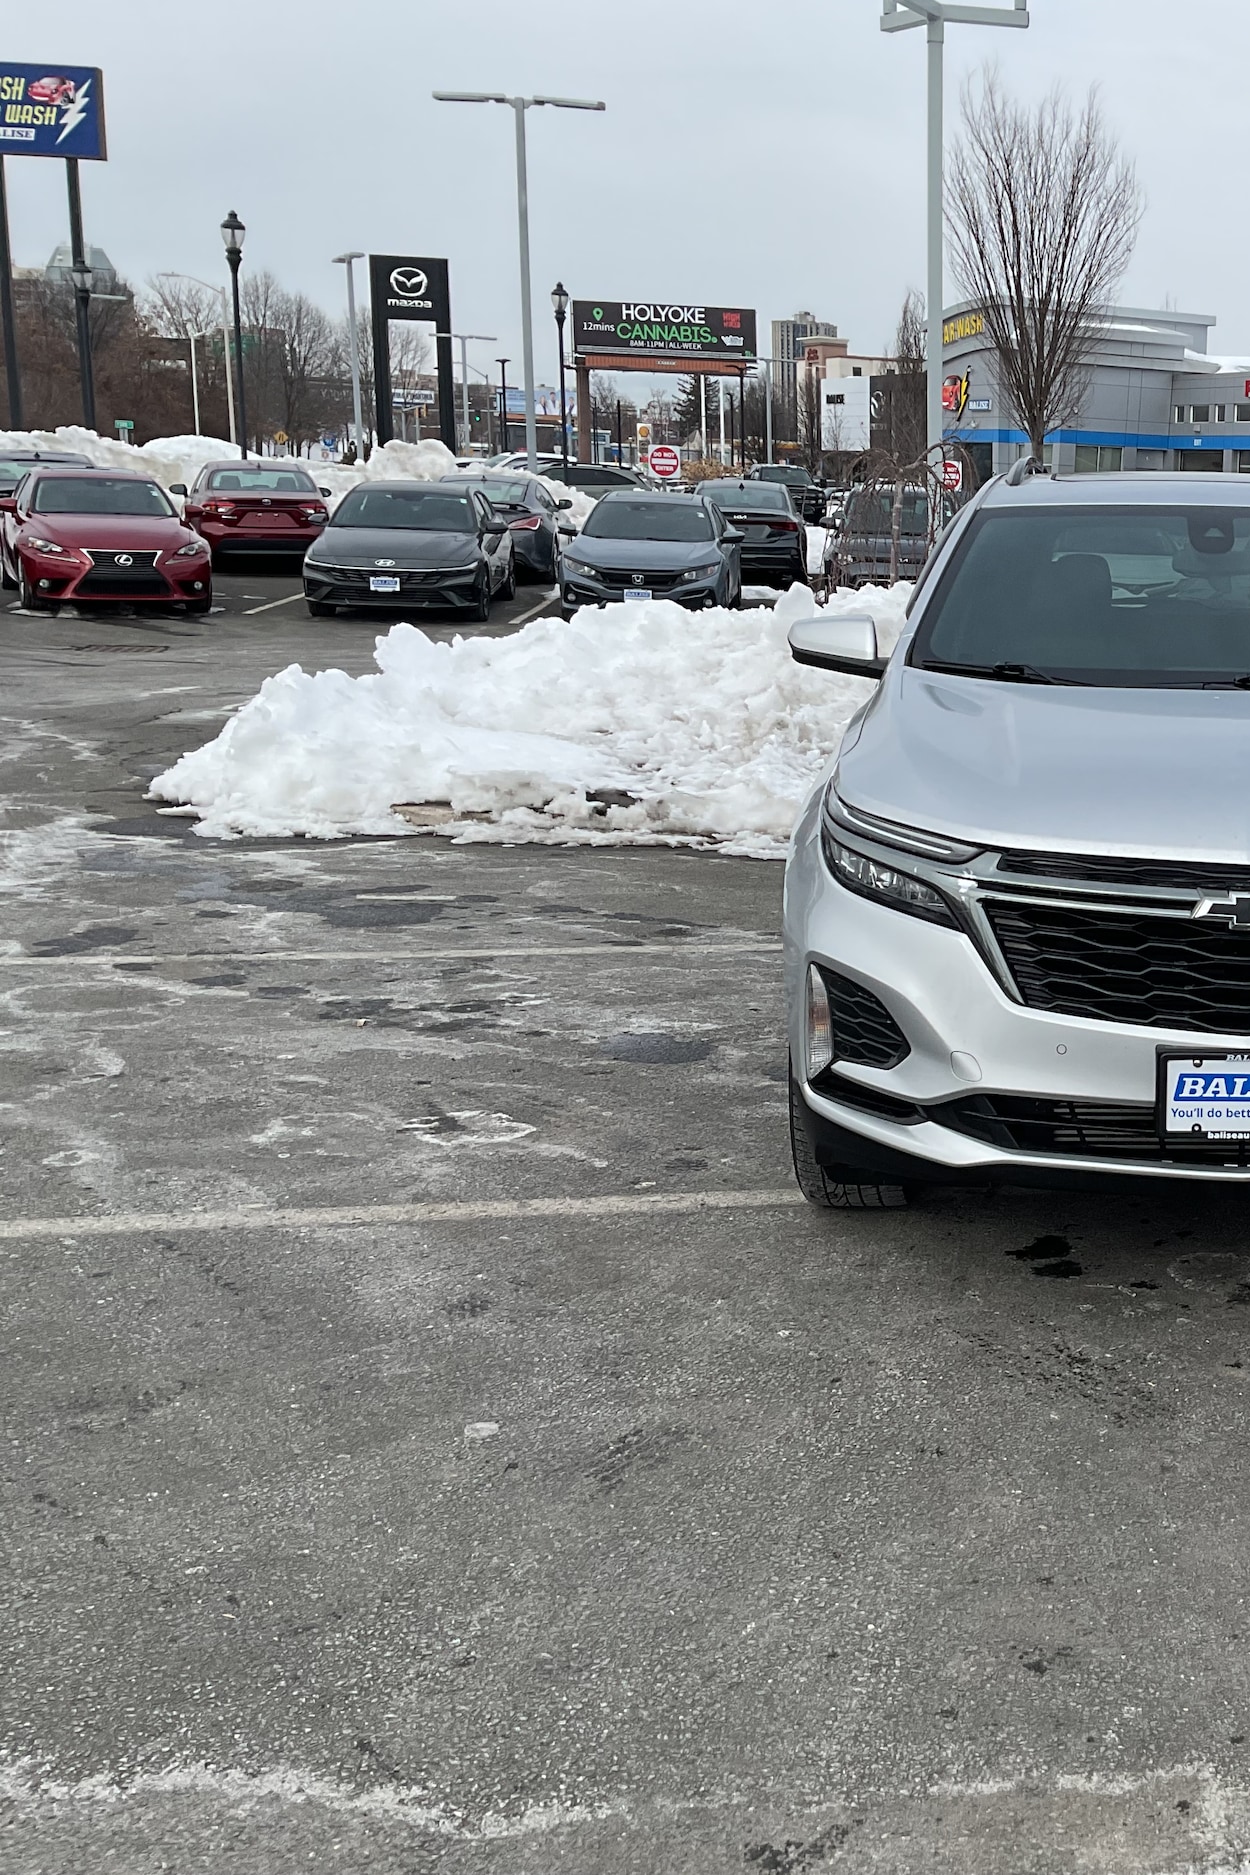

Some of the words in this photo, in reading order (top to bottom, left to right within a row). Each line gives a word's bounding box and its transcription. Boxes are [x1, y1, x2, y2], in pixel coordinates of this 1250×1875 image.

[0, 76, 25, 100] SH
[5, 104, 57, 125] WASH
[0, 129, 33, 139] LISE
[621, 303, 706, 324] HOLYOKE
[582, 321, 616, 332] 12mins
[943, 322, 956, 345] AR
[956, 312, 984, 339] WASH
[1207, 1108, 1222, 1118] do
